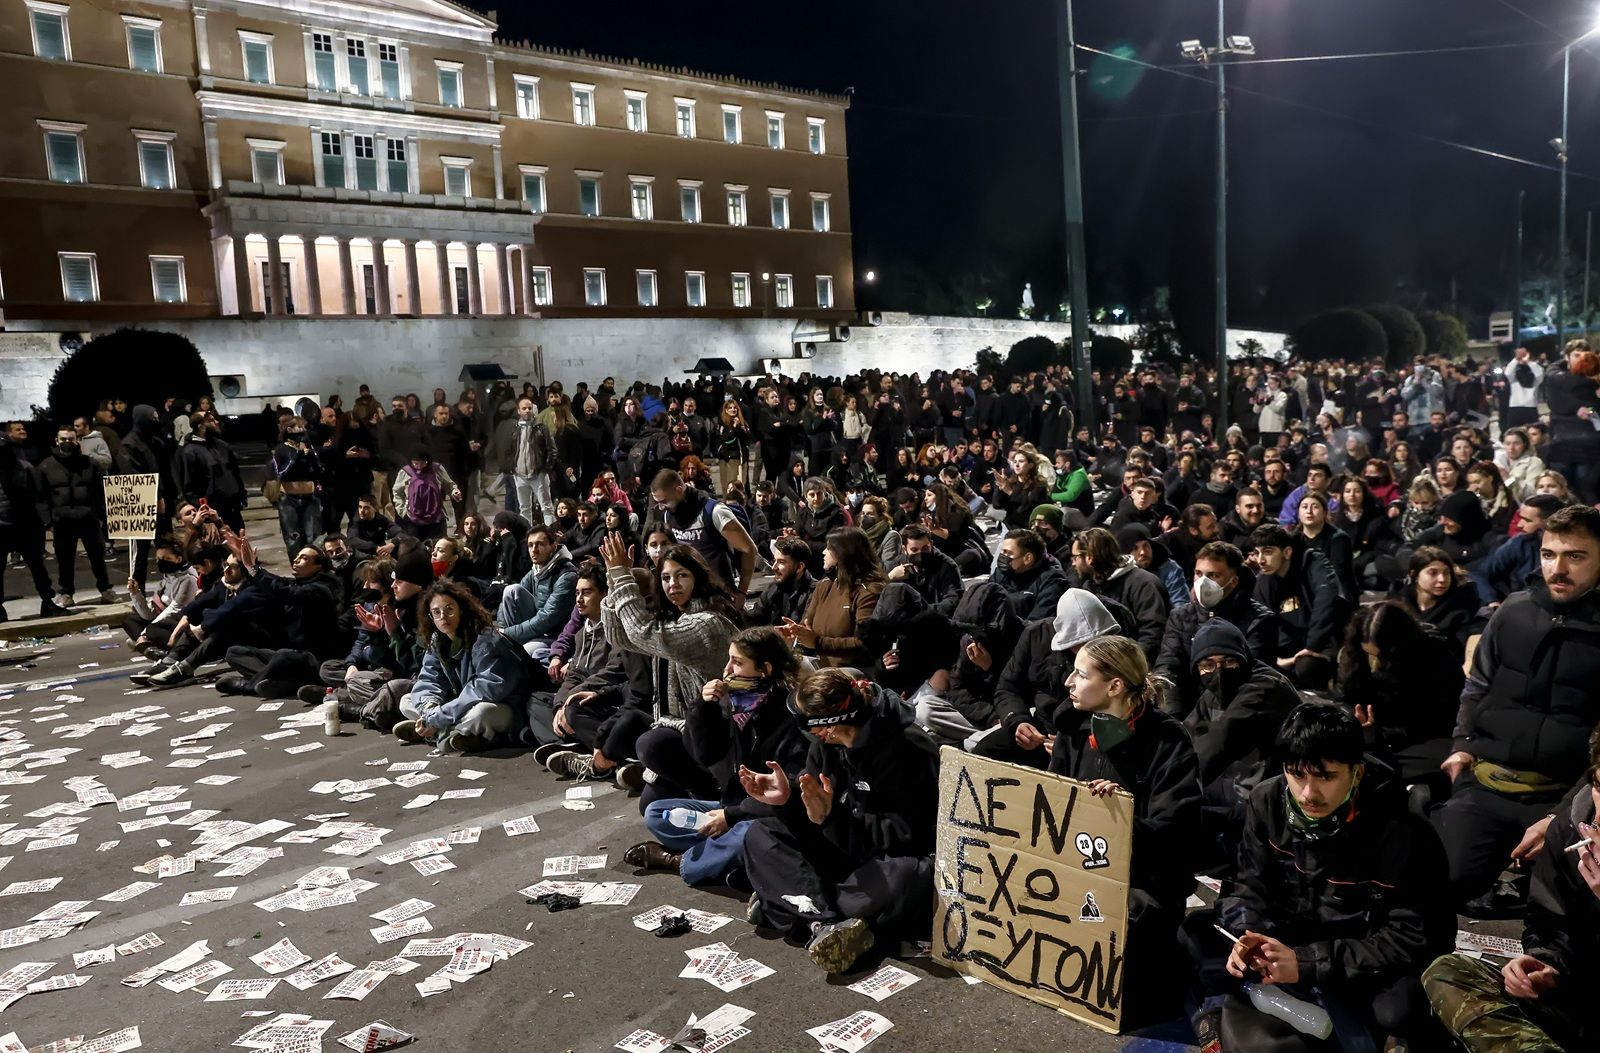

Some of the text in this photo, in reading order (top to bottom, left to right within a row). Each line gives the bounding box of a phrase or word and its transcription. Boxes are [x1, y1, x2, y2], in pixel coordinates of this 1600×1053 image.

[147, 504, 158, 516] ΣΕ
[130, 518, 158, 532] ΚΑΜΠΟ
[808, 710, 858, 726] SCOTT
[950, 766, 1078, 854] ΔΕΝ
